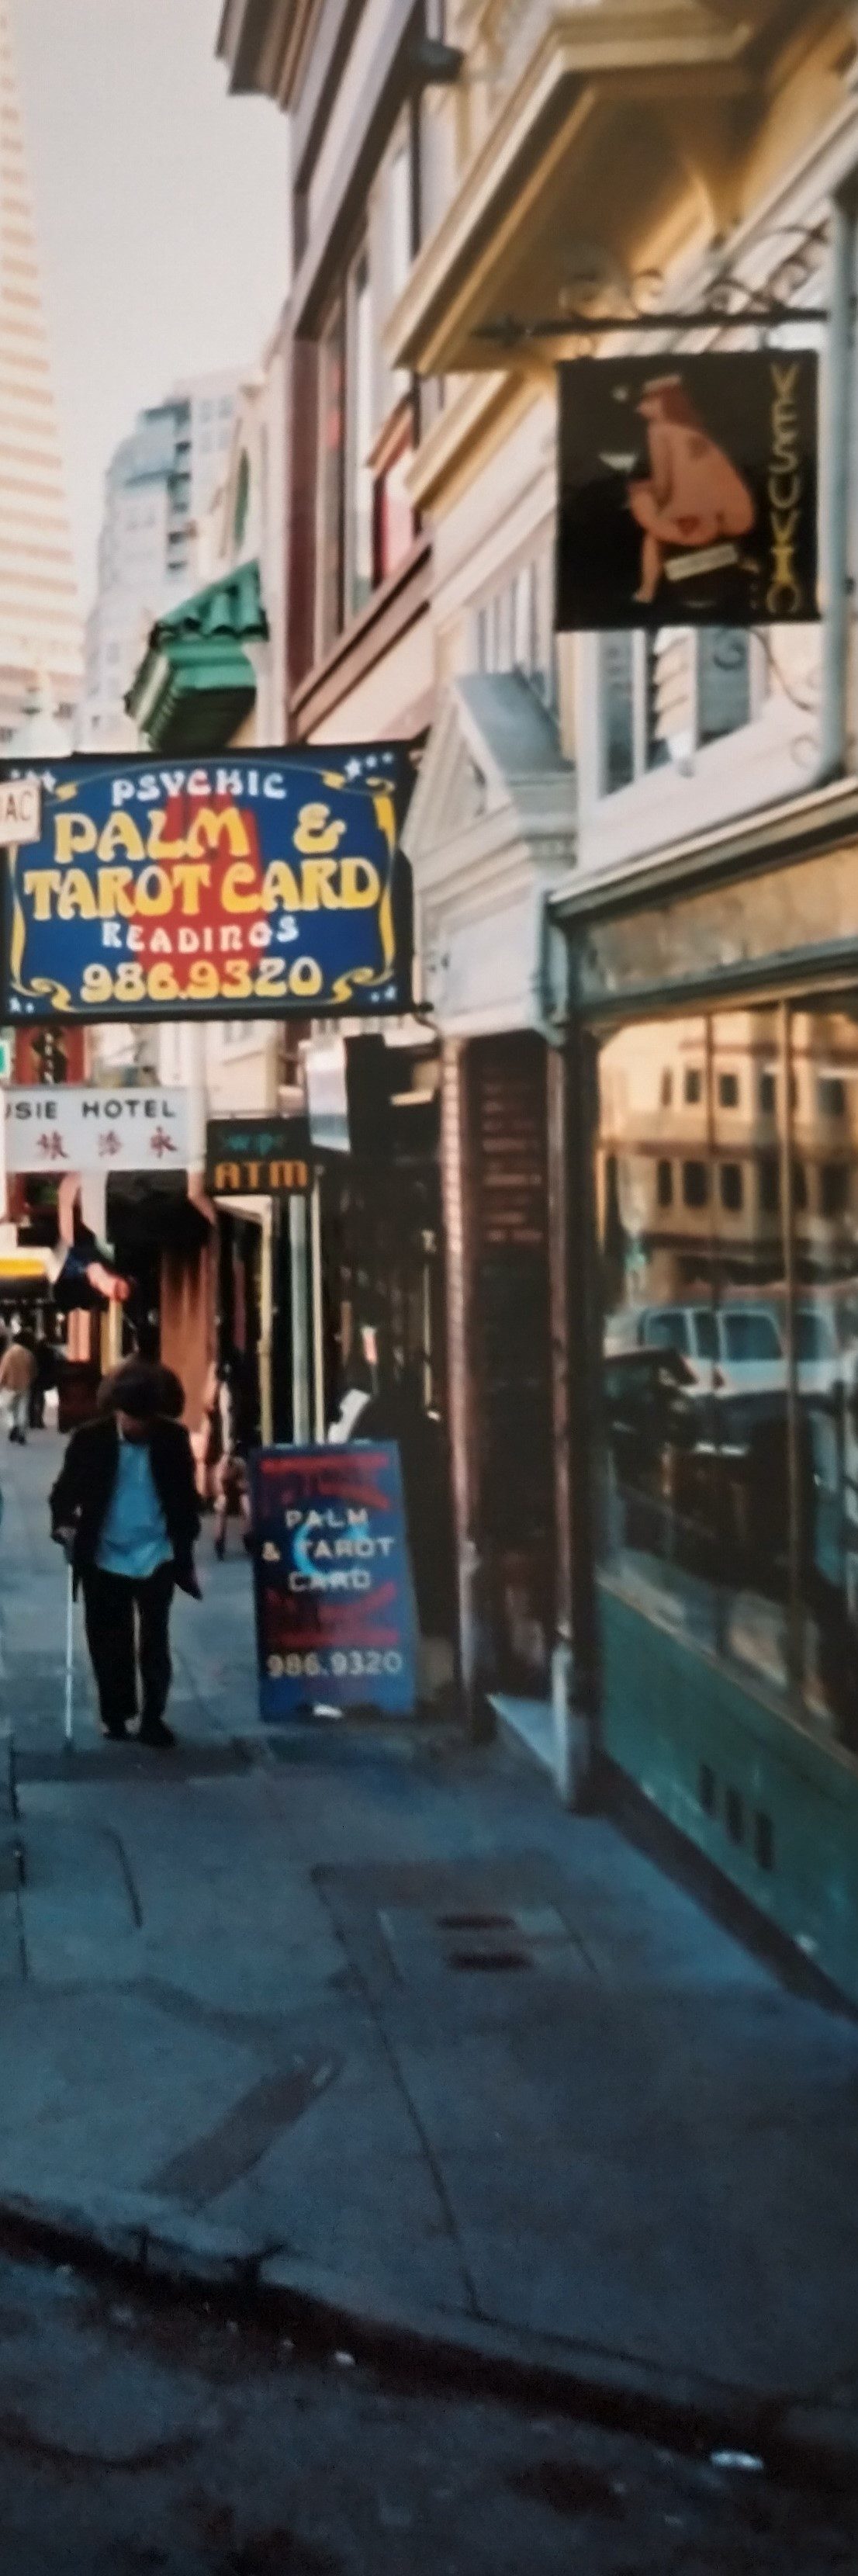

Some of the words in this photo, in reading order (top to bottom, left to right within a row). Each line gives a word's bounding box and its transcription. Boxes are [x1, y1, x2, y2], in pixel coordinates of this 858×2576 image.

[767, 362, 801, 615] VESUVIO
[112, 769, 287, 805] PSYCHIC
[54, 806, 251, 863] PALM
[293, 802, 346, 853] &
[24, 864, 211, 920] TAROT
[221, 858, 380, 913] CARD
[102, 916, 299, 954] READINGS
[81, 957, 322, 1002] 986.9320
[81, 1099, 175, 1120] HOTEL
[215, 1160, 307, 1189] ATM
[284, 1508, 368, 1529] PALM
[261, 1541, 281, 1561] &
[299, 1537, 394, 1560] TAROT
[288, 1570, 371, 1592] CARD
[266, 1650, 403, 1678] 986.9320
